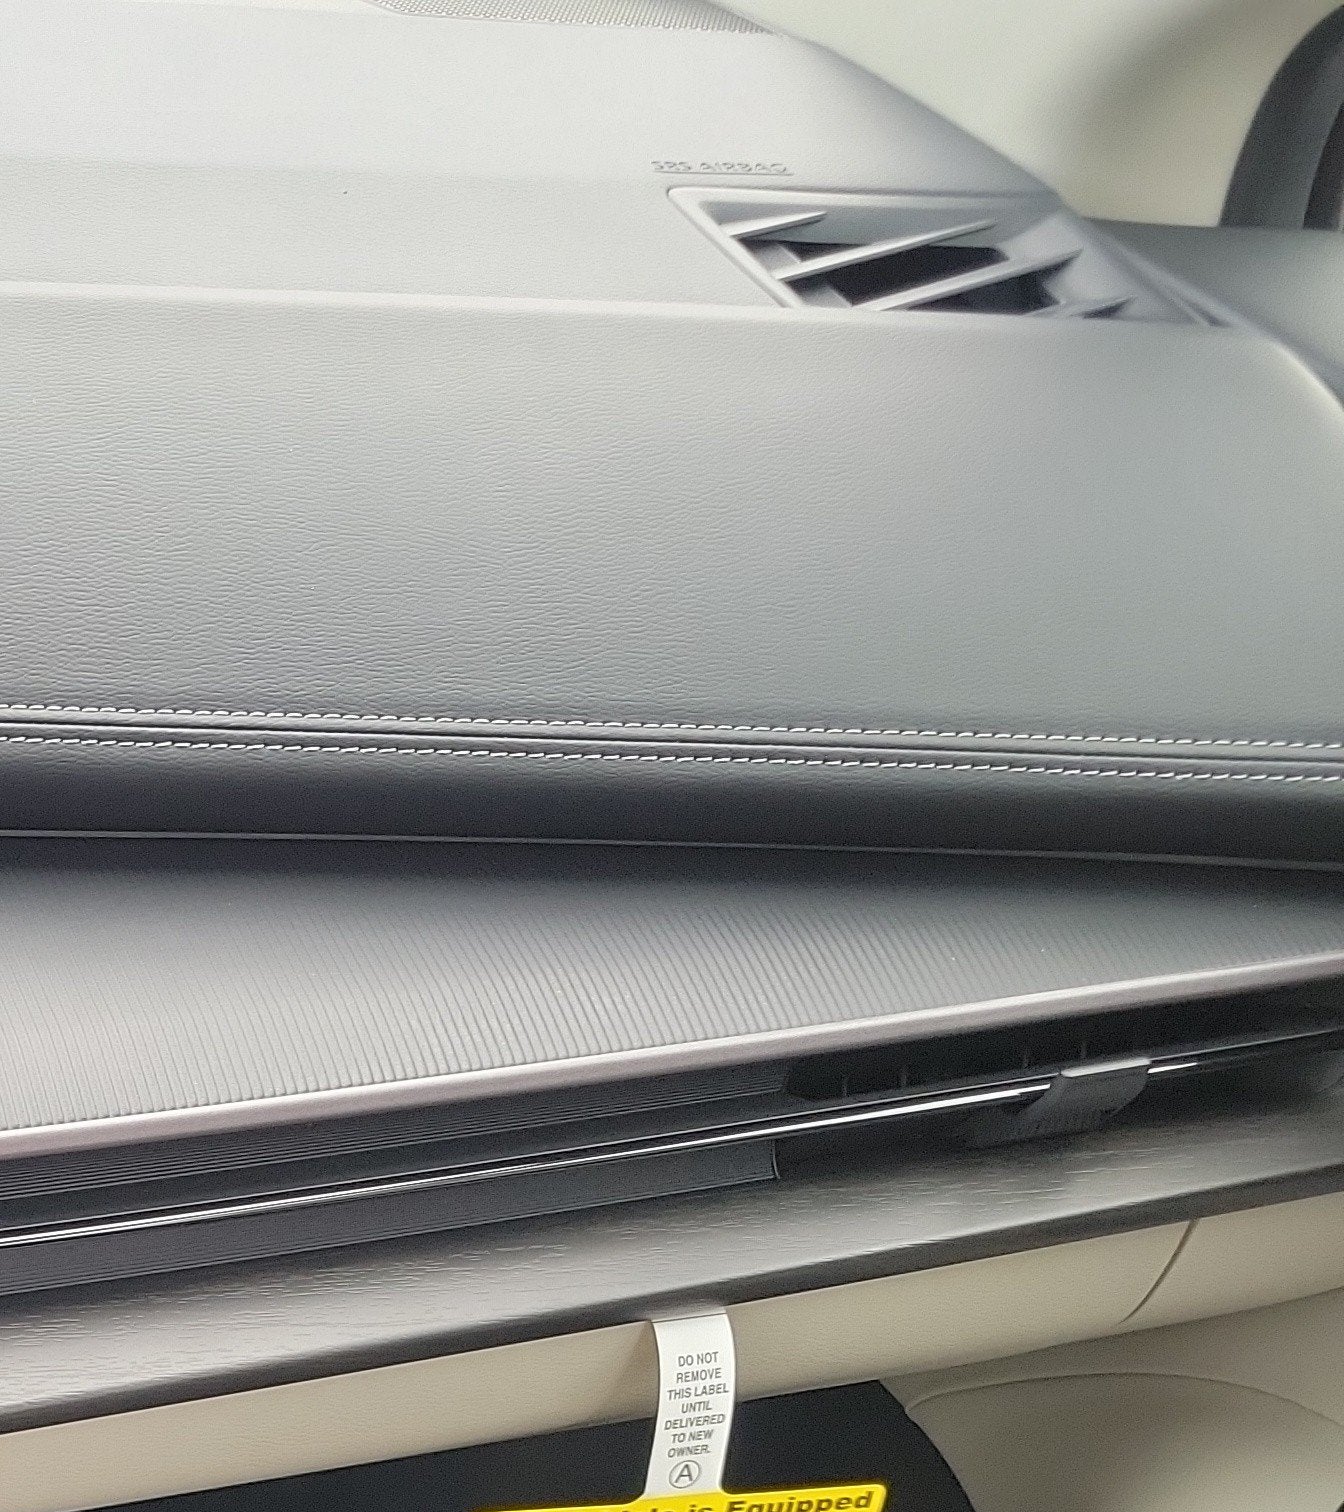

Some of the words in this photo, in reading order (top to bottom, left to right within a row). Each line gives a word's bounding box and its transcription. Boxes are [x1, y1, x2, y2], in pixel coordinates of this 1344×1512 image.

[678, 1355, 694, 1367] DO
[697, 1352, 719, 1364] NOT
[676, 1368, 722, 1383] REMOVE
[667, 1388, 691, 1401] THIS
[694, 1383, 729, 1397] LABEL
[681, 1401, 712, 1414] UNTIL
[664, 1414, 726, 1430] DELIVERED
[672, 1433, 686, 1443] TO
[688, 1429, 714, 1441] NEW
[668, 1445, 711, 1458] OWNER.
[675, 1464, 694, 1484] A
